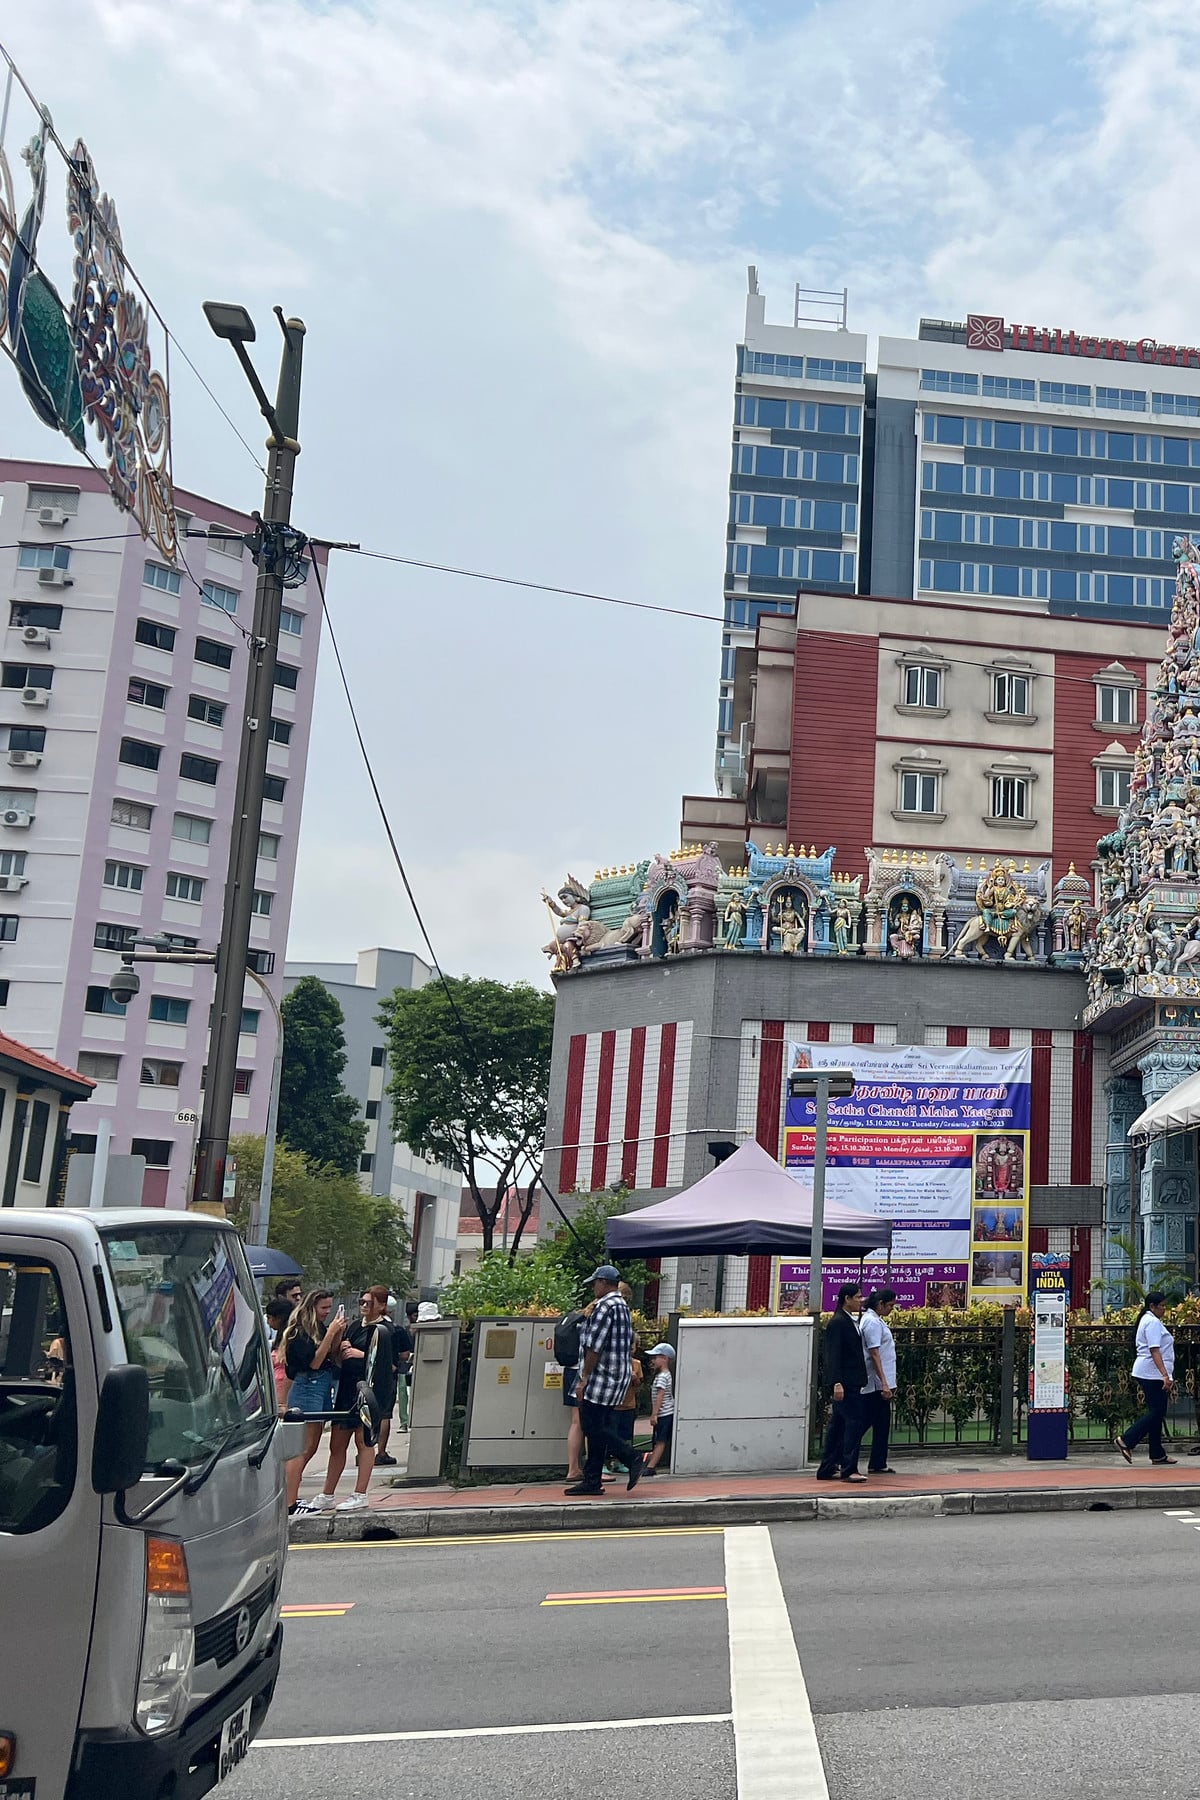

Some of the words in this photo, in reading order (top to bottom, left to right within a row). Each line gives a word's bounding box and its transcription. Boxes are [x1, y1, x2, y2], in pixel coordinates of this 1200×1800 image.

[1009, 324, 1127, 360] Hilton
[178, 1112, 196, 1122] 668
[827, 1103, 865, 1116] Satha
[868, 1104, 917, 1118] Chandi
[919, 1106, 959, 1118] Maha
[961, 1106, 1014, 1121] Yaagam
[839, 1136, 888, 1145] Participation
[792, 1266, 841, 1274] Thirllaku
[1036, 1277, 1065, 1288] INDIA
